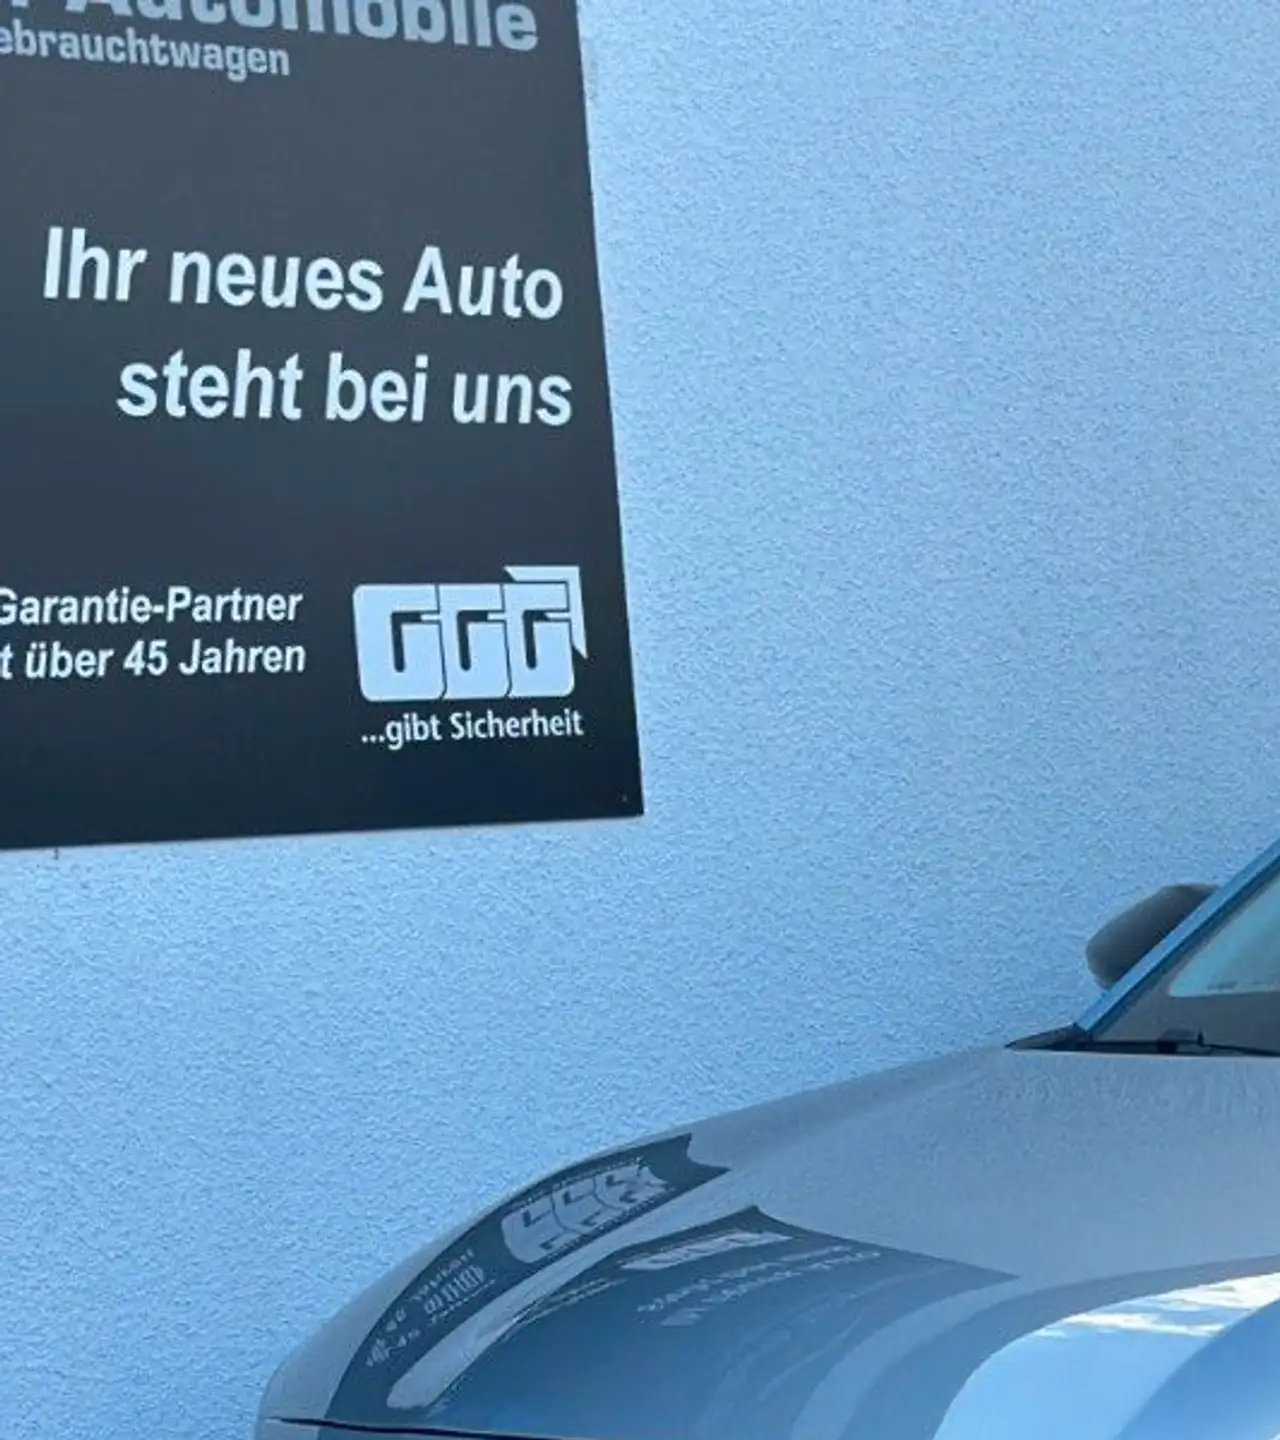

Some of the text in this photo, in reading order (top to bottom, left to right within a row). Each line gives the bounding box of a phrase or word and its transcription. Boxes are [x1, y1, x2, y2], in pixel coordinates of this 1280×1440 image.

[65, 0, 538, 51] omobile
[43, 226, 563, 319] Ihr neues Auto
[116, 348, 572, 426] steht bei uns
[26, 640, 115, 679] über
[123, 639, 168, 676] 45
[178, 638, 306, 675] Jahren
[450, 706, 584, 741] Sicherheit
